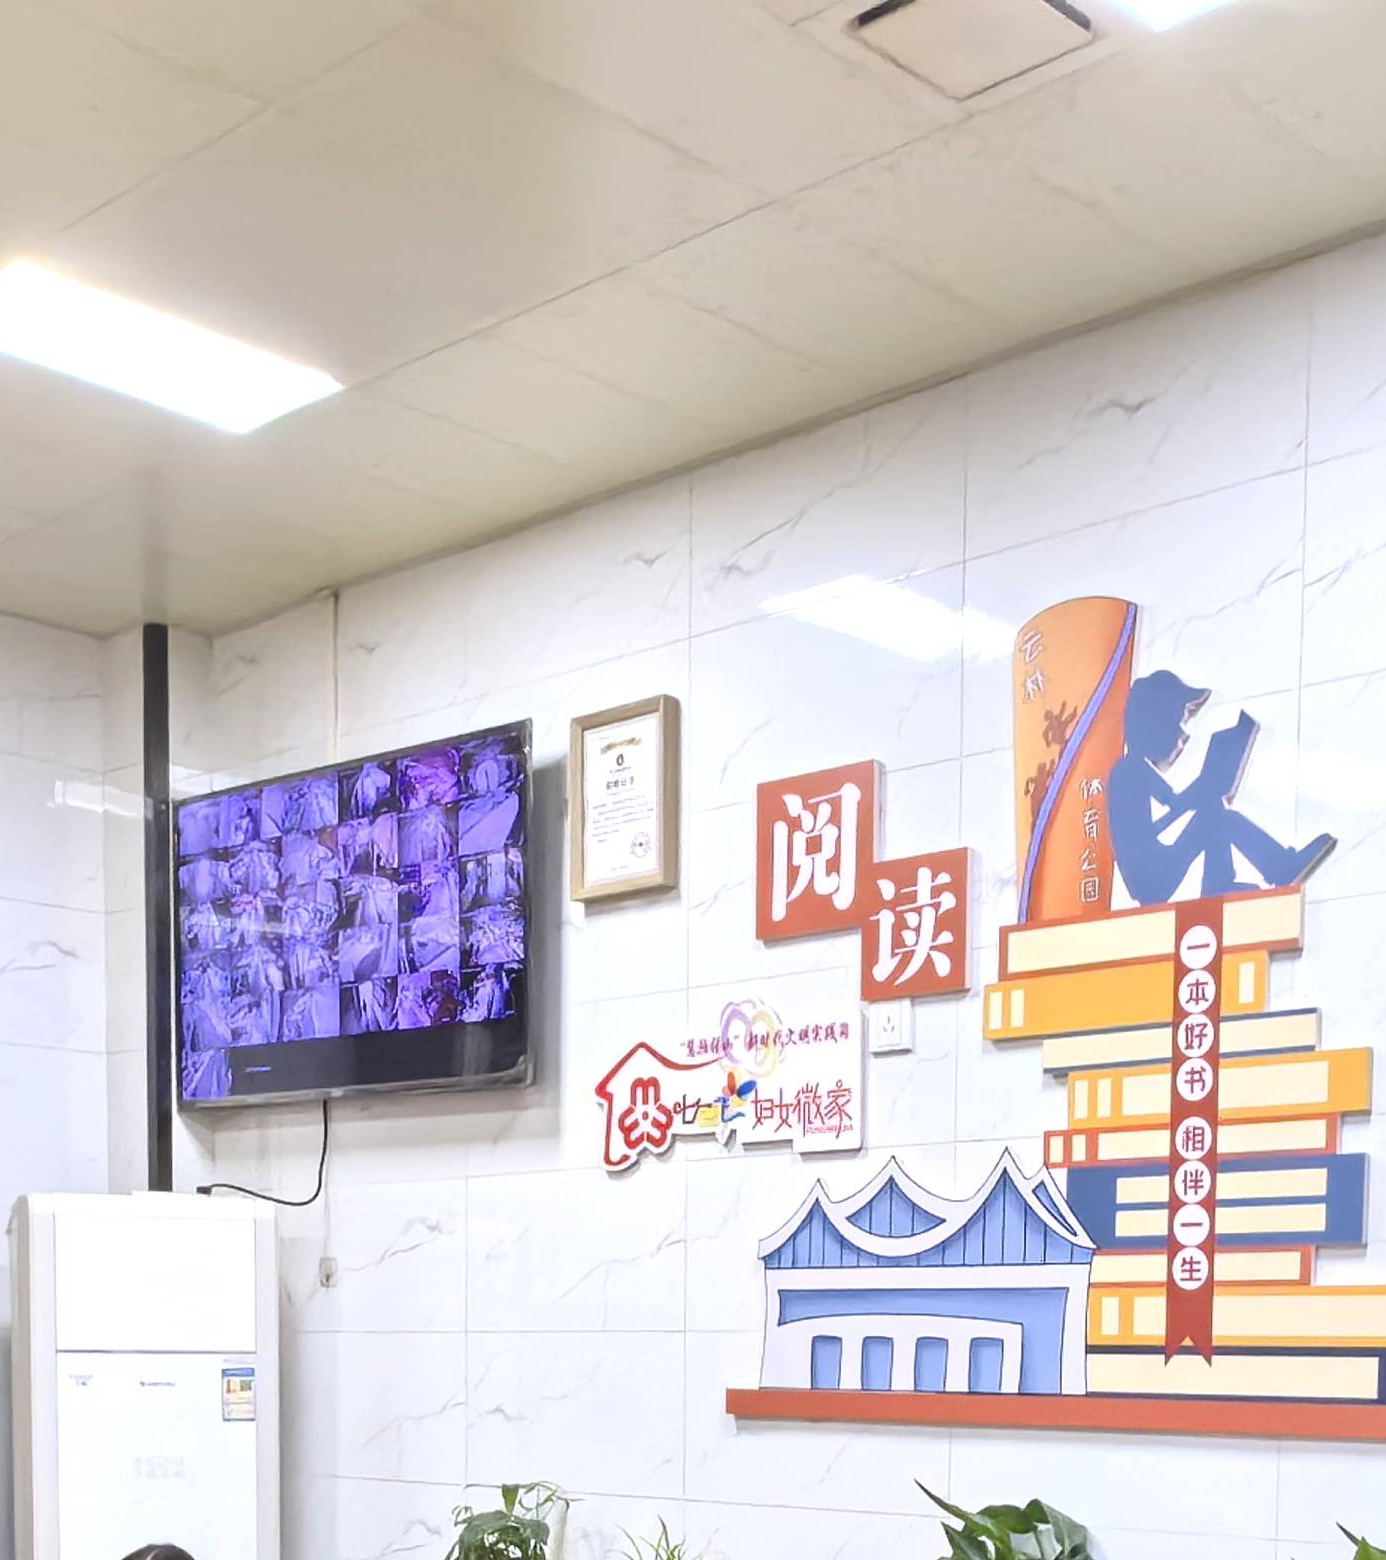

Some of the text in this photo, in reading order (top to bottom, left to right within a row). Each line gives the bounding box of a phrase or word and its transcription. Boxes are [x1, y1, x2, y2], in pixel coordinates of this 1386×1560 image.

[771, 782, 957, 986] 阅读
[751, 1080, 853, 1140] 妇女微家
[1179, 942, 1211, 1282] 一本好书 相伴一生
